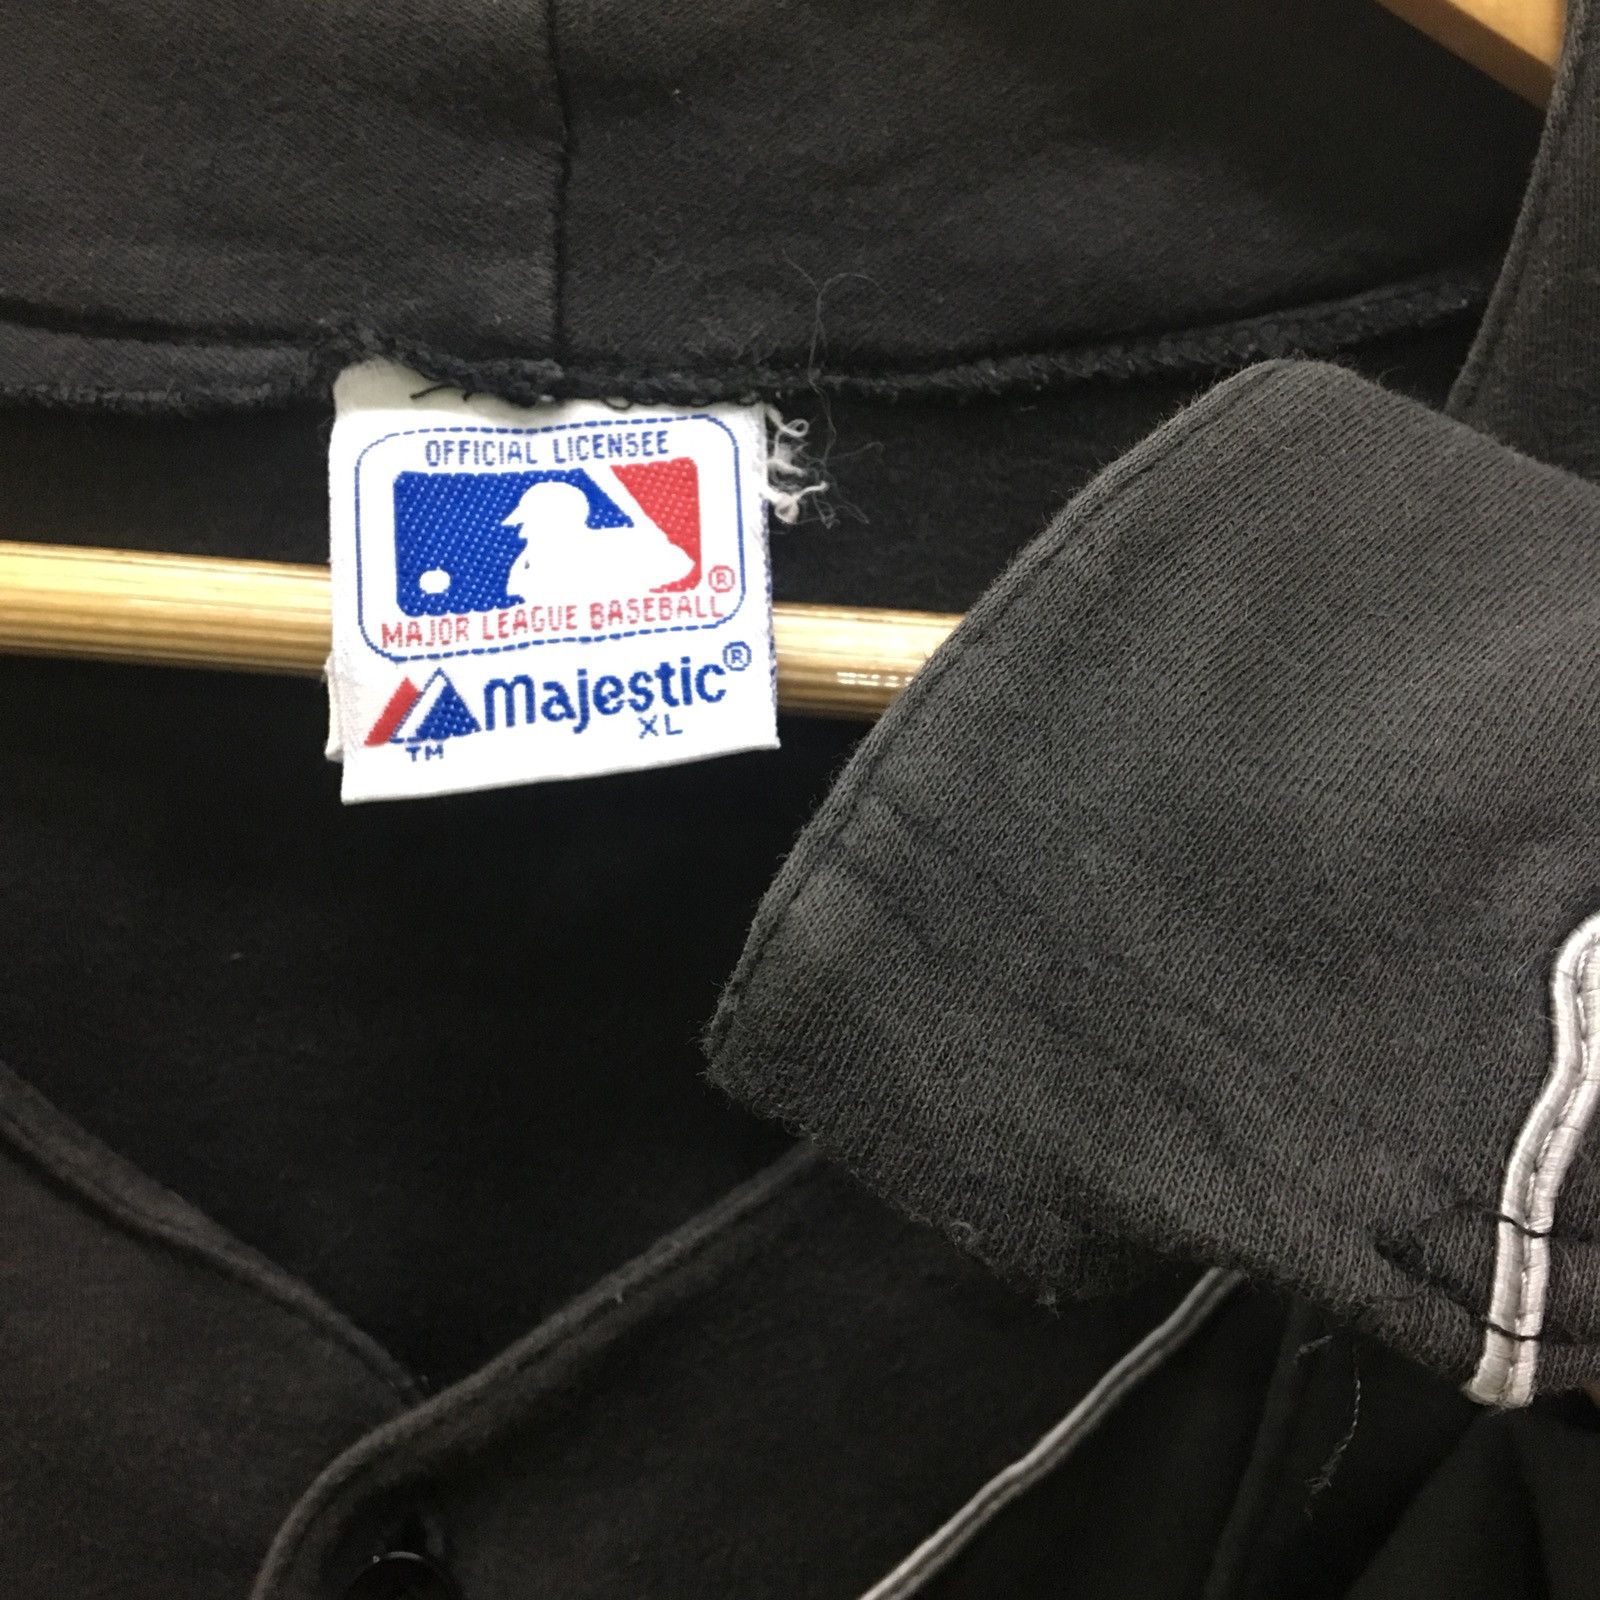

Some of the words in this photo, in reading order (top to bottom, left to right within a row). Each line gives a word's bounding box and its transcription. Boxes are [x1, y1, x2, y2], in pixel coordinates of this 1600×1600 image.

[425, 438, 538, 466] OFFICIAL
[552, 430, 669, 463] LICENSEE
[381, 617, 470, 648] MAJOR
[482, 605, 578, 641] LEAGUE
[589, 595, 725, 631] BASEBALL
[638, 713, 684, 739] XL
[405, 743, 445, 762] TM
